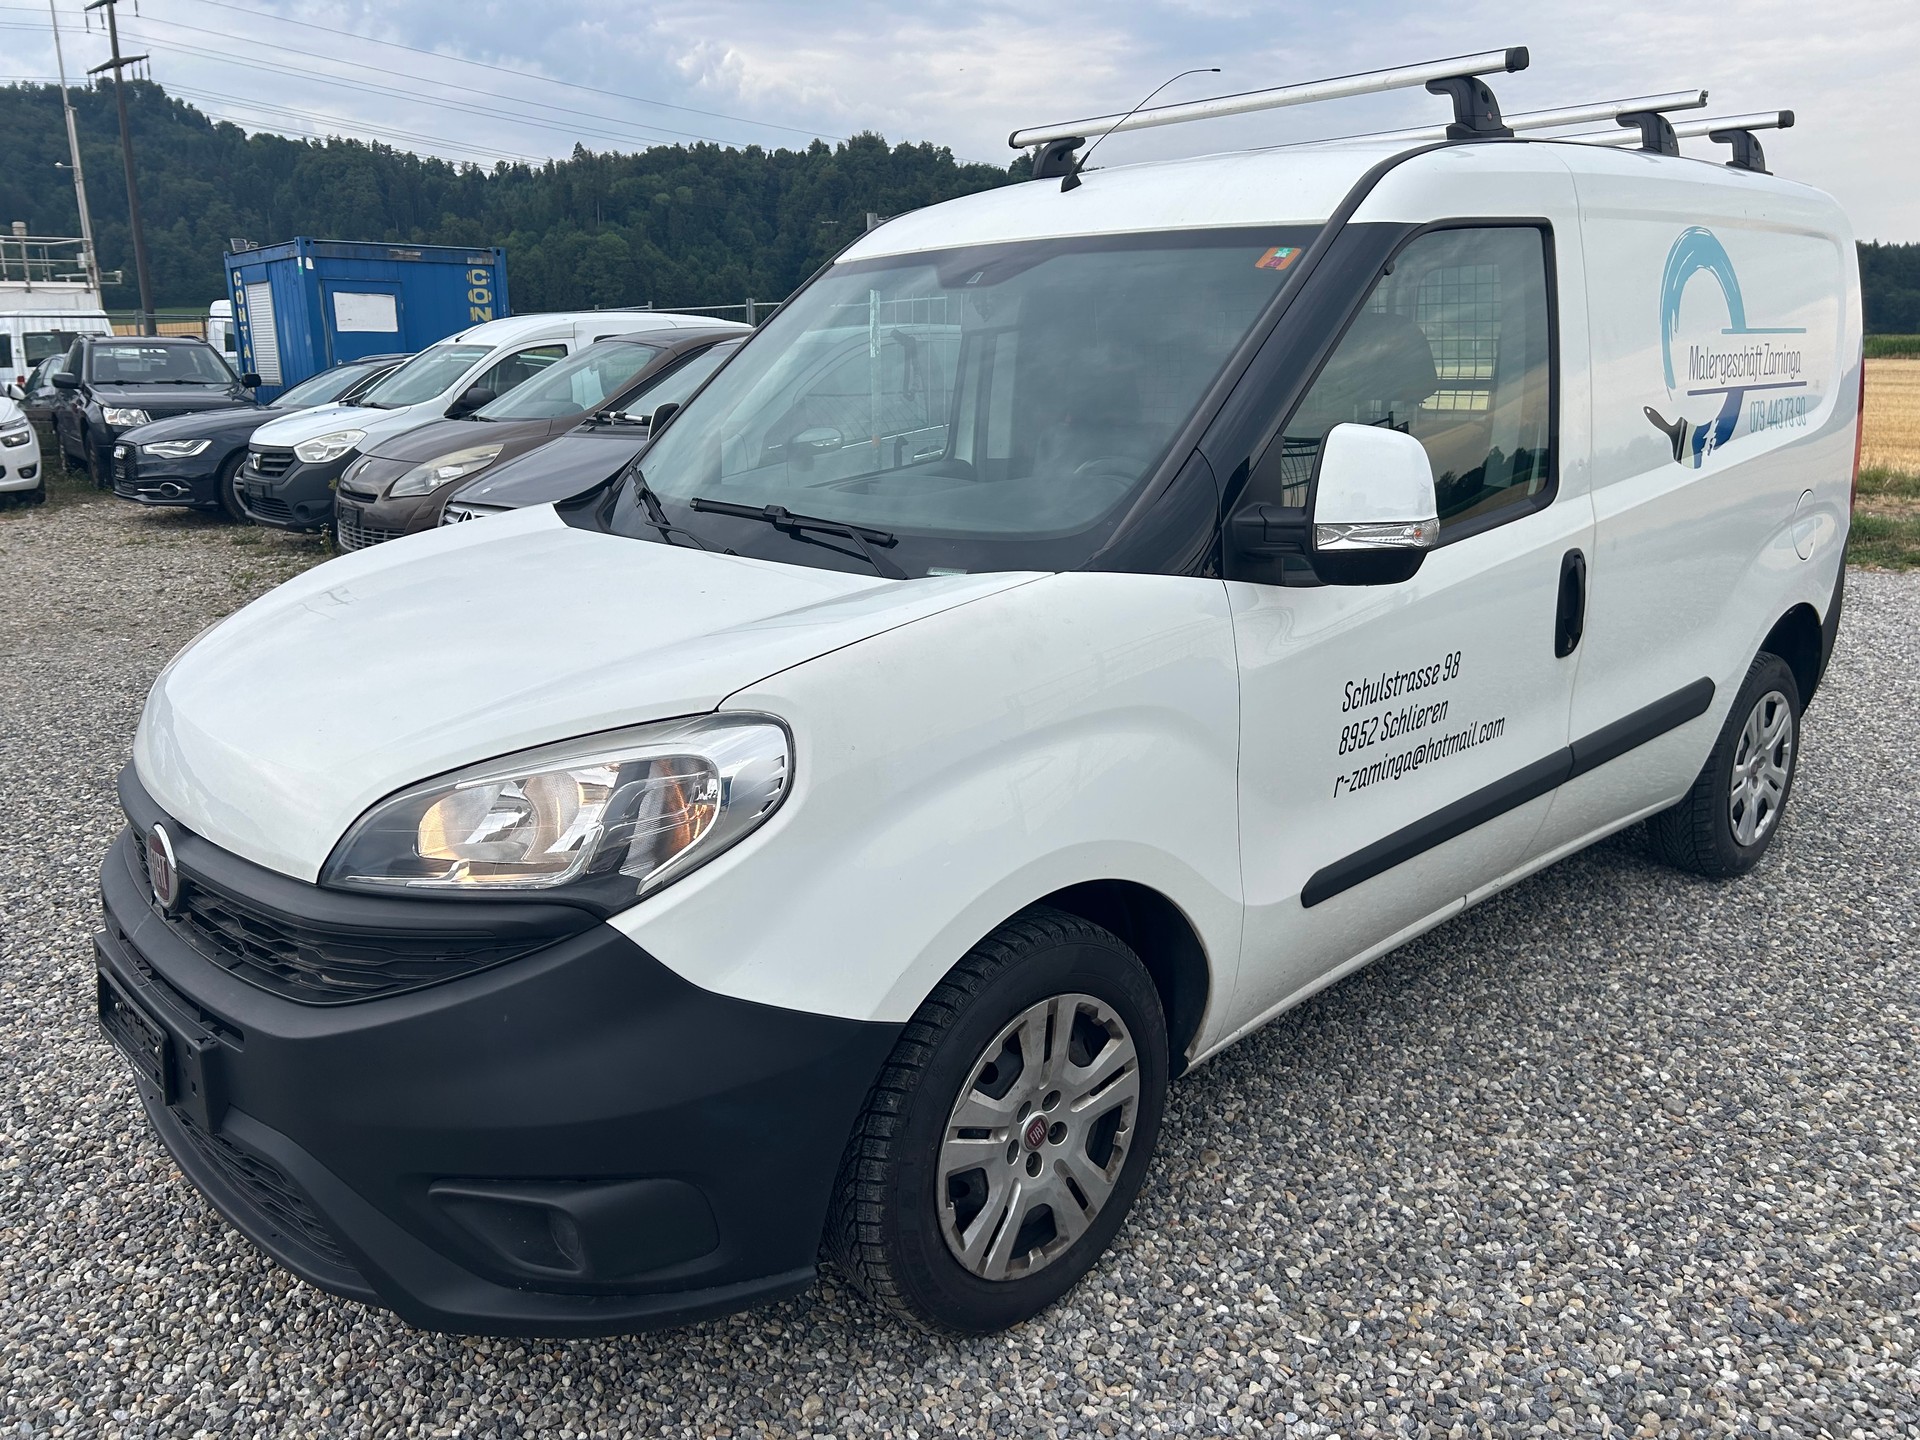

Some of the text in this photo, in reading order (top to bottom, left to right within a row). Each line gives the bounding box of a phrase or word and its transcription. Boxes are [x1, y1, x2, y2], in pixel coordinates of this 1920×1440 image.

[233, 271, 255, 392] CONTAI
[1688, 345, 1762, 385] Malergeschäft
[1750, 396, 1807, 433] 079 443 73 90
[1342, 650, 1462, 713] Schulstrasse 98
[1338, 700, 1449, 756] 8952 Schlieren
[1333, 717, 1506, 799] r-zaminga@hotmail.com
[1029, 1121, 1046, 1144] FIAT
